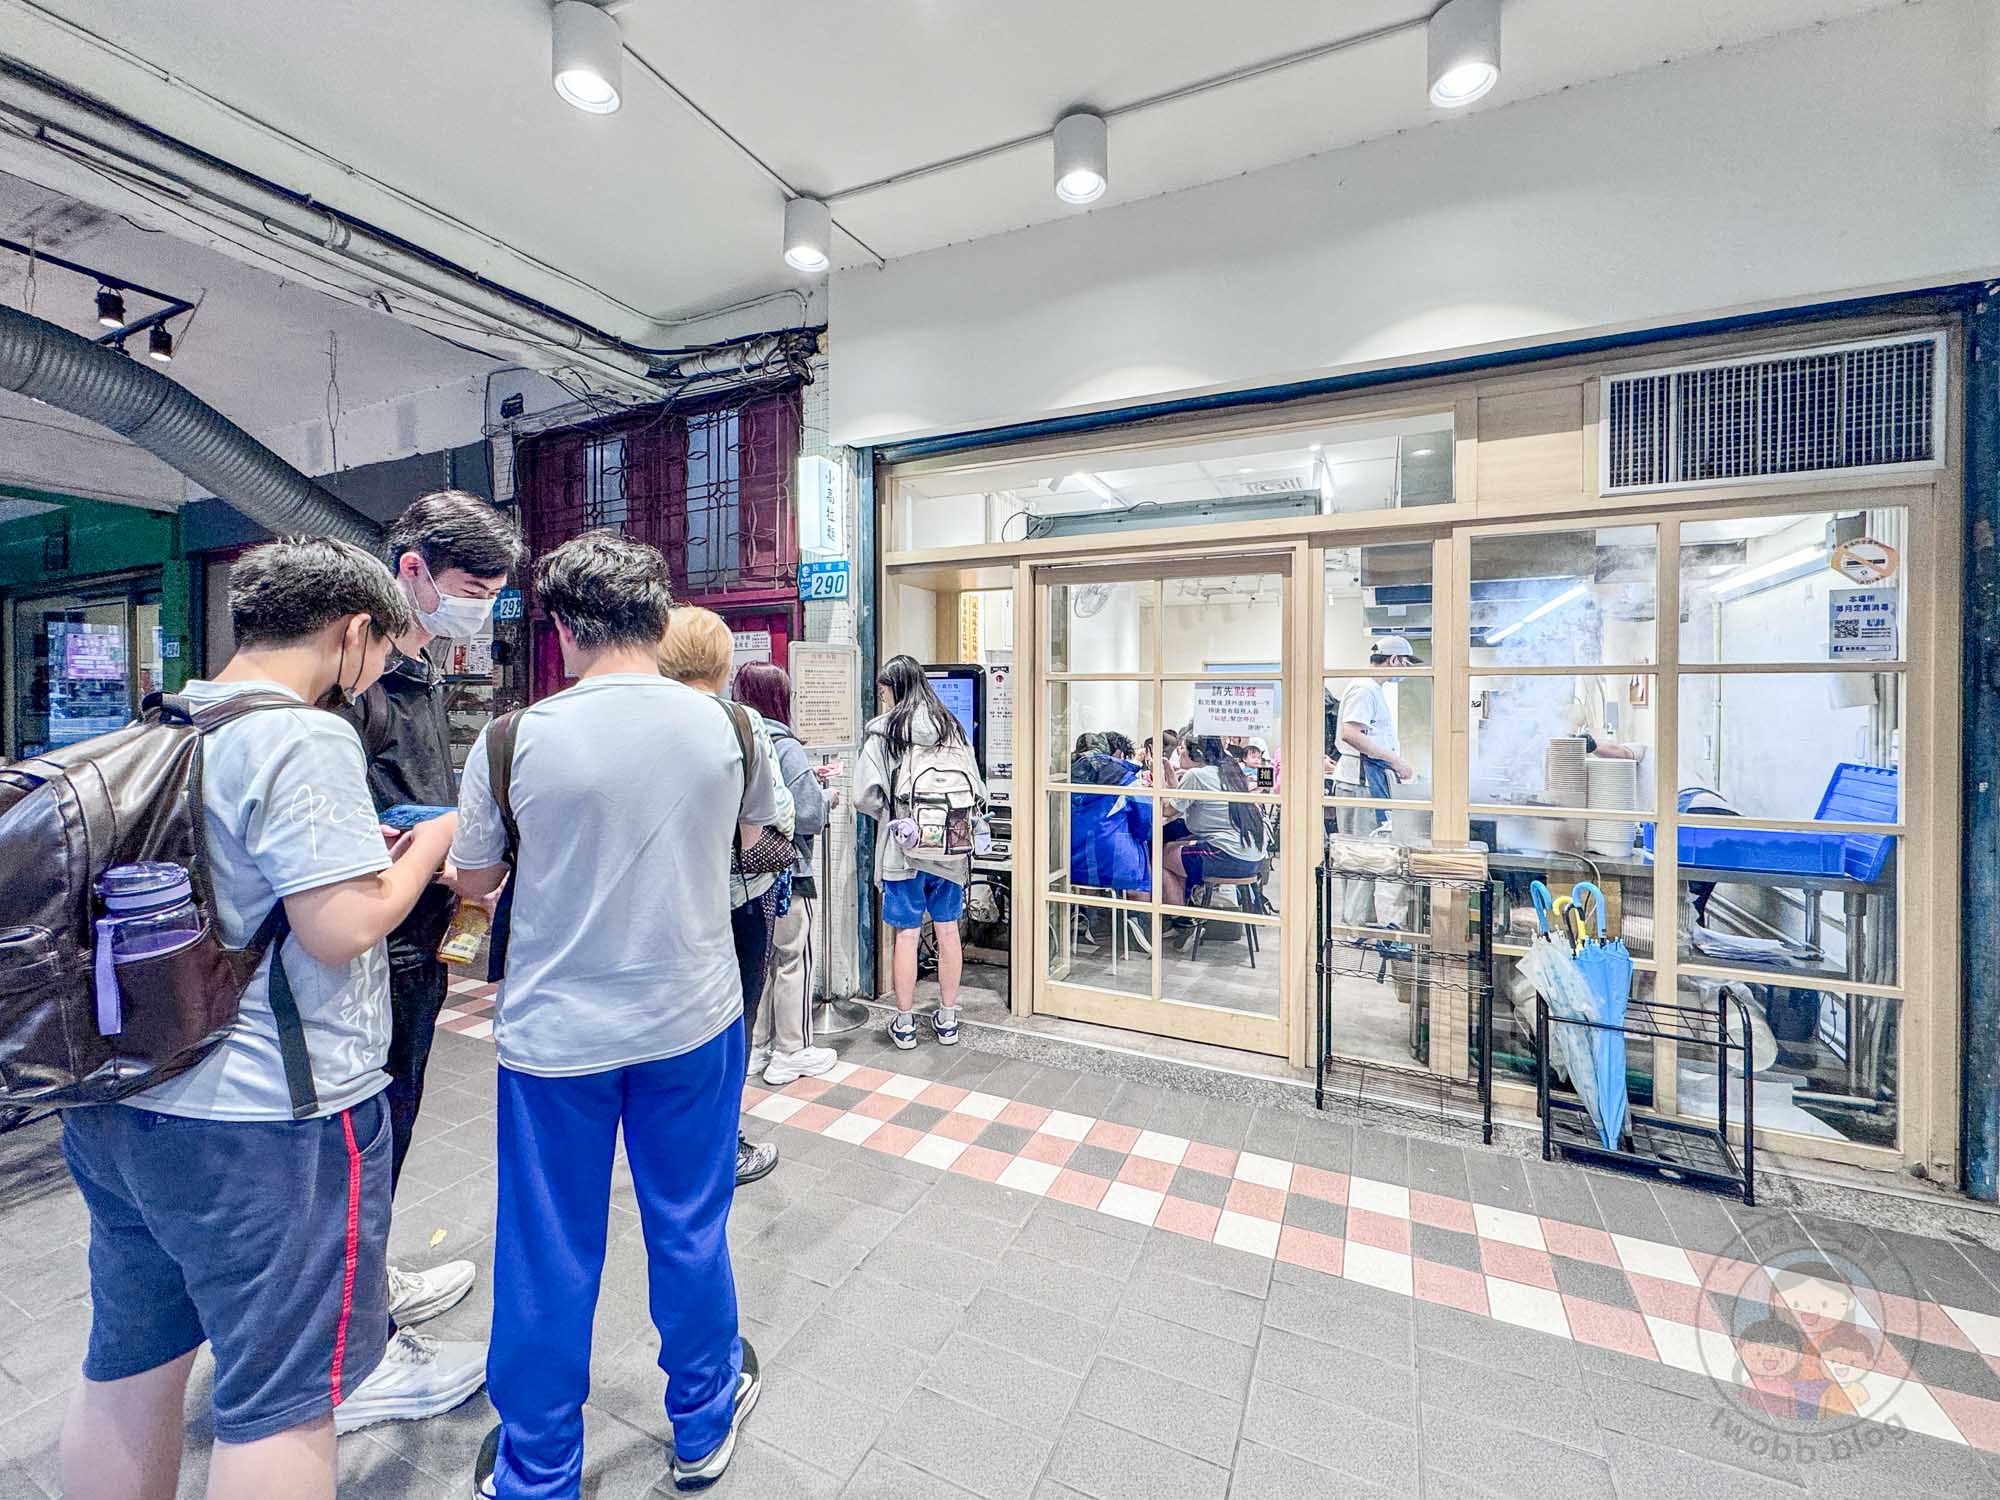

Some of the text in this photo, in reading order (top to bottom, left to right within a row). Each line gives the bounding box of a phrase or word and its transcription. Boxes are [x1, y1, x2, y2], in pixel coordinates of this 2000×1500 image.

[814, 574, 845, 596] 290
[1212, 686, 1257, 697] 請先點餐
[1260, 769, 1271, 780] 推
